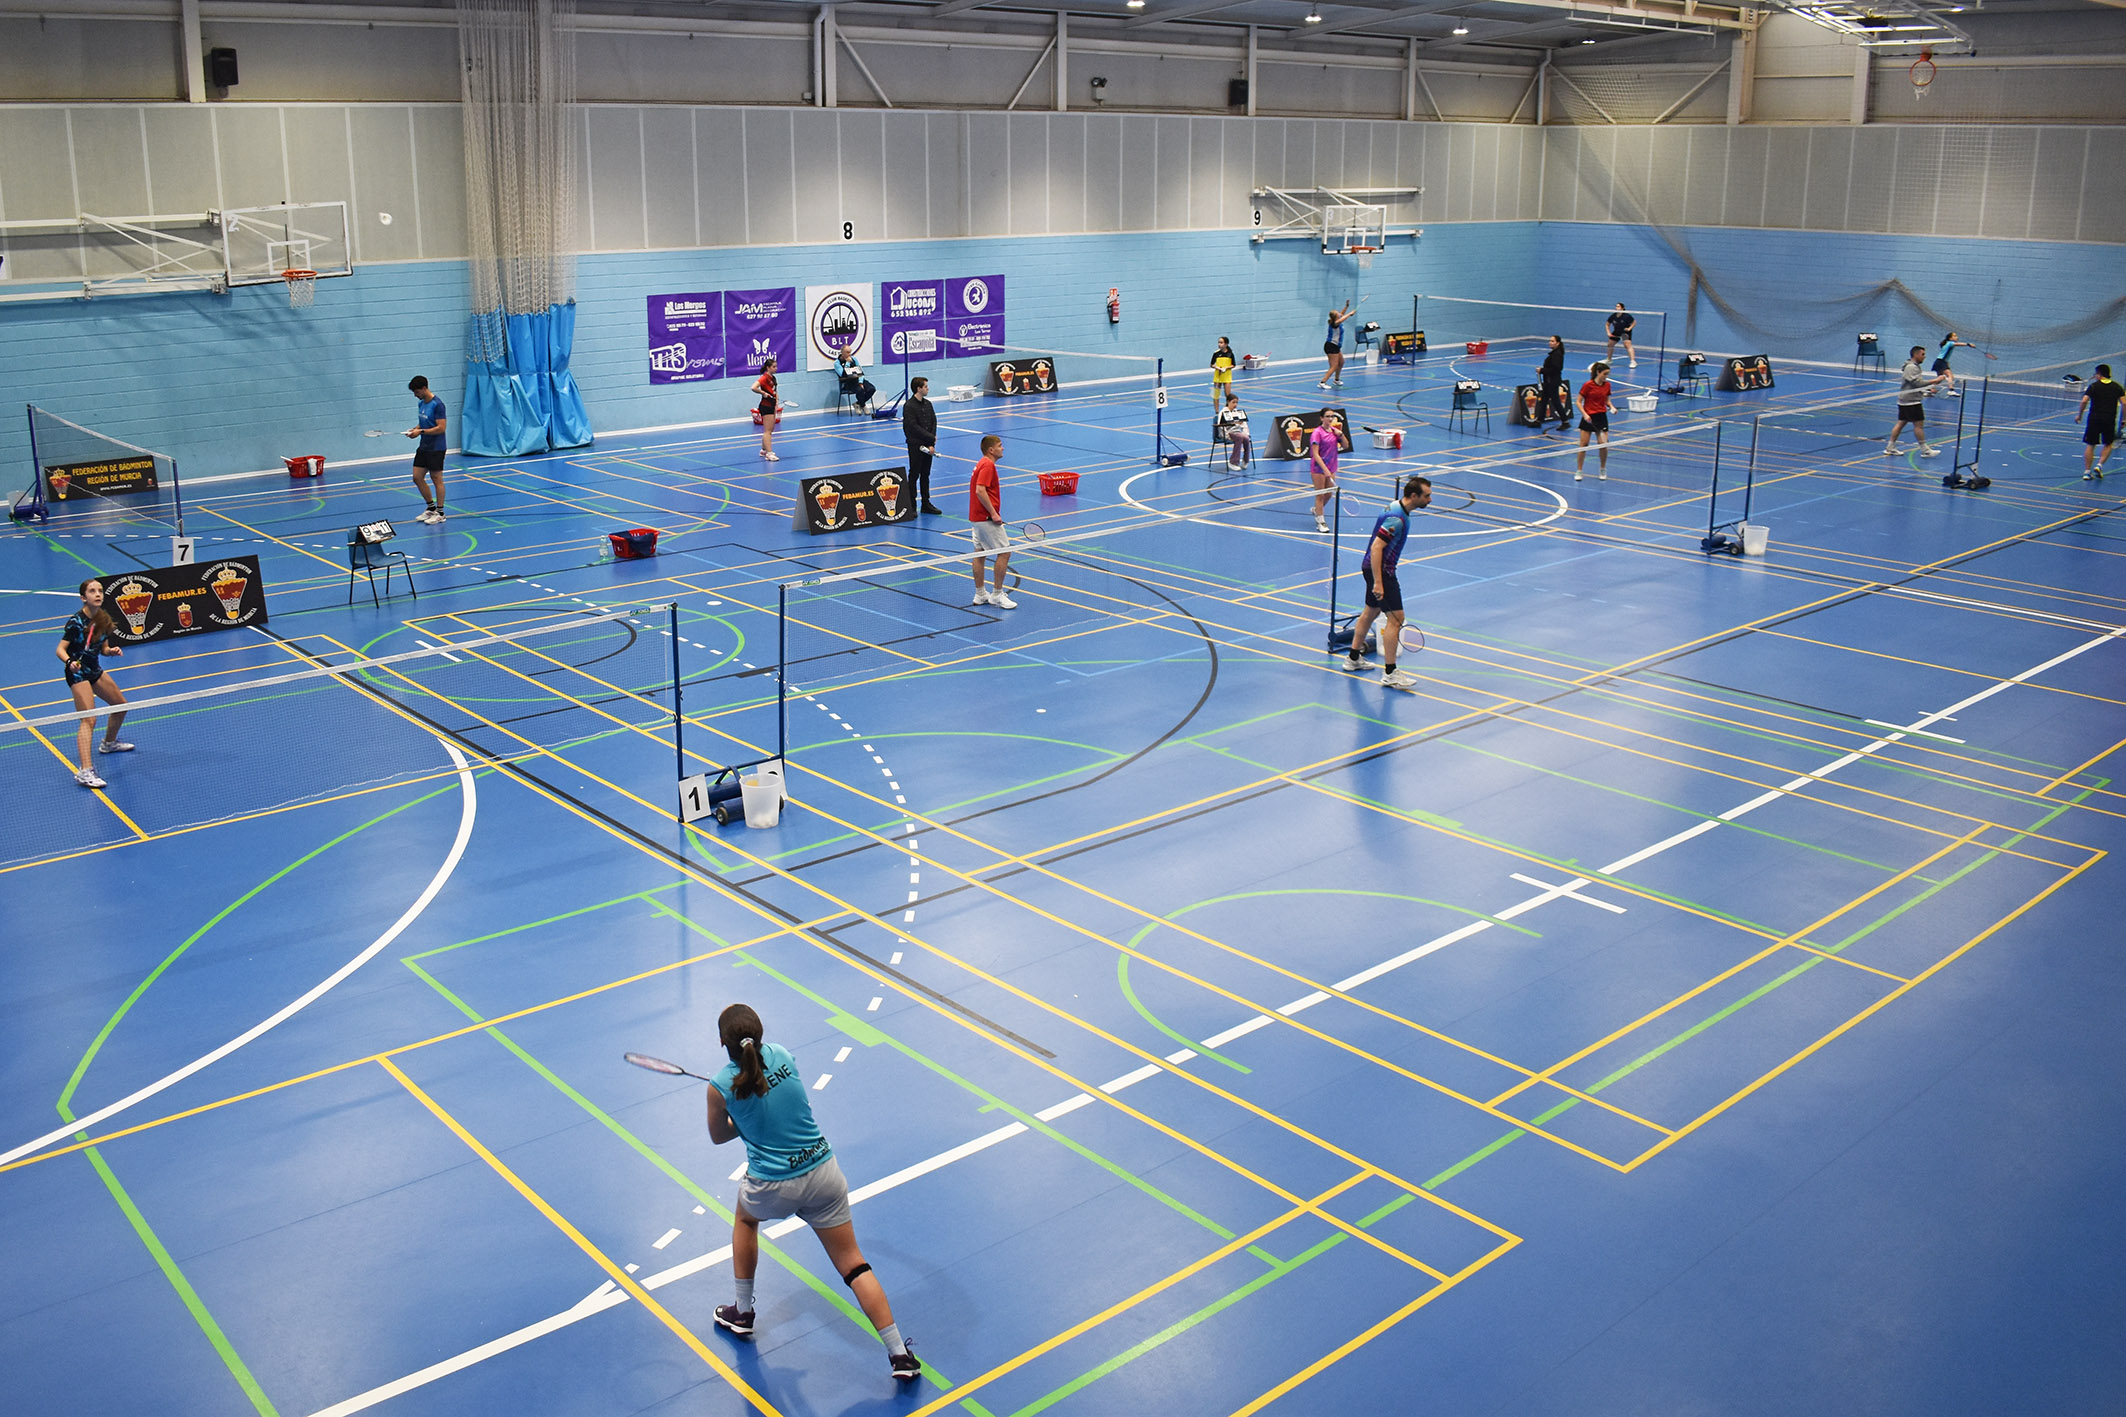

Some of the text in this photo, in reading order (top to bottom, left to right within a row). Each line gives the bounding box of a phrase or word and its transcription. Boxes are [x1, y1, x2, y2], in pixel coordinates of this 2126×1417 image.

[1254, 210, 1261, 225] 9
[843, 221, 853, 240] 8
[1158, 391, 1165, 405] 8
[109, 464, 118, 472] DE
[110, 474, 118, 482] DE
[119, 472, 142, 481] MURCIA
[362, 526, 372, 537] 9
[177, 544, 190, 562] 7
[157, 587, 207, 600] FEBAMUR.ES
[688, 786, 701, 812] 1
[768, 1064, 792, 1091] ENE
